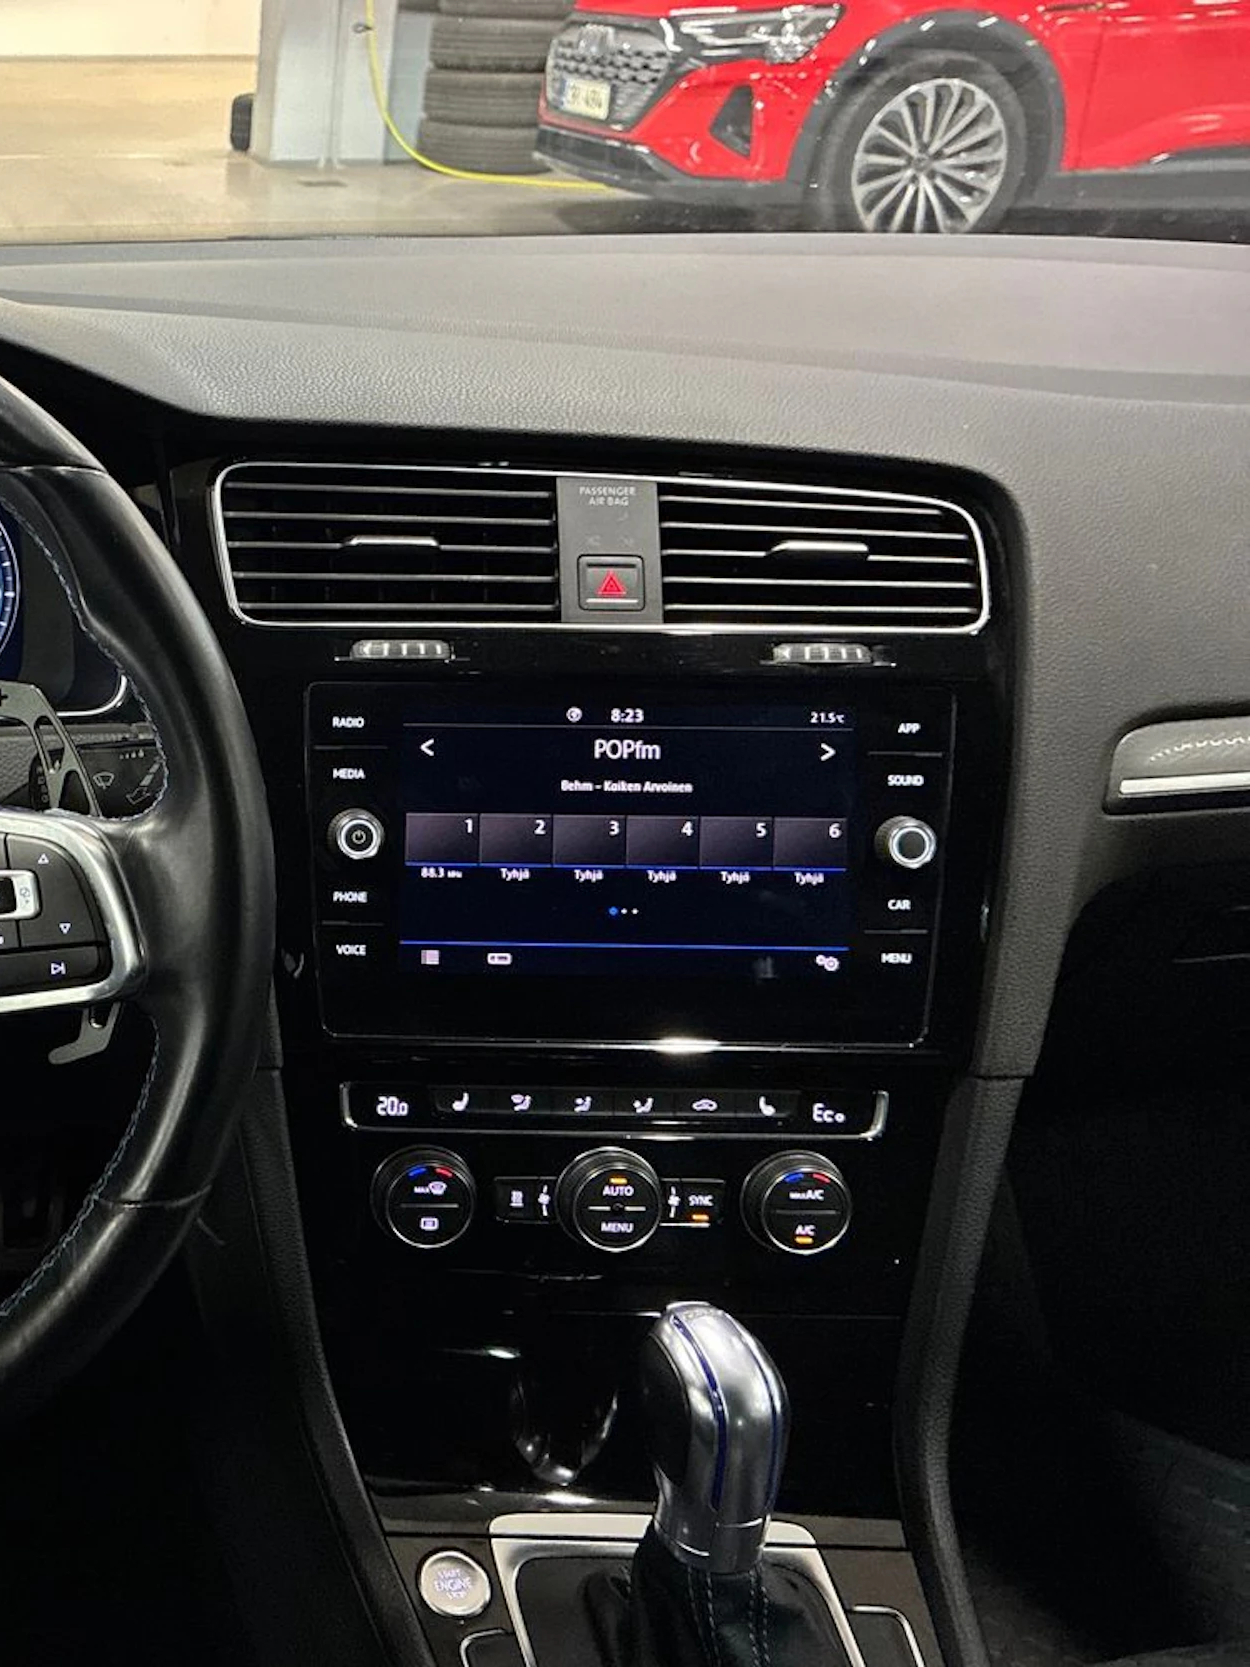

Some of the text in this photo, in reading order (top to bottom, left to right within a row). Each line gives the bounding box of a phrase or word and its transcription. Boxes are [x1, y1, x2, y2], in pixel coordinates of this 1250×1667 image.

[579, 486, 636, 495] PASSENGER
[588, 496, 629, 506] AIR BAG
[610, 708, 643, 722] 8:23
[332, 716, 364, 727] RADIO
[897, 722, 920, 733] APP
[593, 738, 661, 760] POPfm
[332, 767, 365, 779] MEDIA
[560, 779, 593, 791] Behm
[603, 780, 640, 792] Kaiken
[643, 781, 693, 793] Arvoinen
[887, 774, 924, 786] SOUND
[464, 818, 474, 833] 1
[534, 819, 547, 834] 2
[608, 820, 620, 835] 3
[681, 821, 694, 836] 4
[755, 822, 767, 837] 5
[828, 823, 841, 838] 6
[421, 867, 444, 878] 88.3
[500, 868, 529, 881] Tyhjä
[574, 869, 603, 881] Tyhjä
[647, 870, 676, 882] Tyhjä
[720, 871, 750, 883] Tyhjä
[794, 872, 824, 885] Tyhjä
[332, 890, 367, 902] PHONE
[887, 899, 910, 910] CAR
[336, 944, 366, 955] VOICE
[881, 953, 912, 964] MENU
[602, 1186, 633, 1196] AUTO
[688, 1195, 713, 1206] SYNC
[601, 1222, 633, 1232] MENU
[795, 1225, 815, 1235] A/C
[434, 1576, 471, 1591] ENGINE
